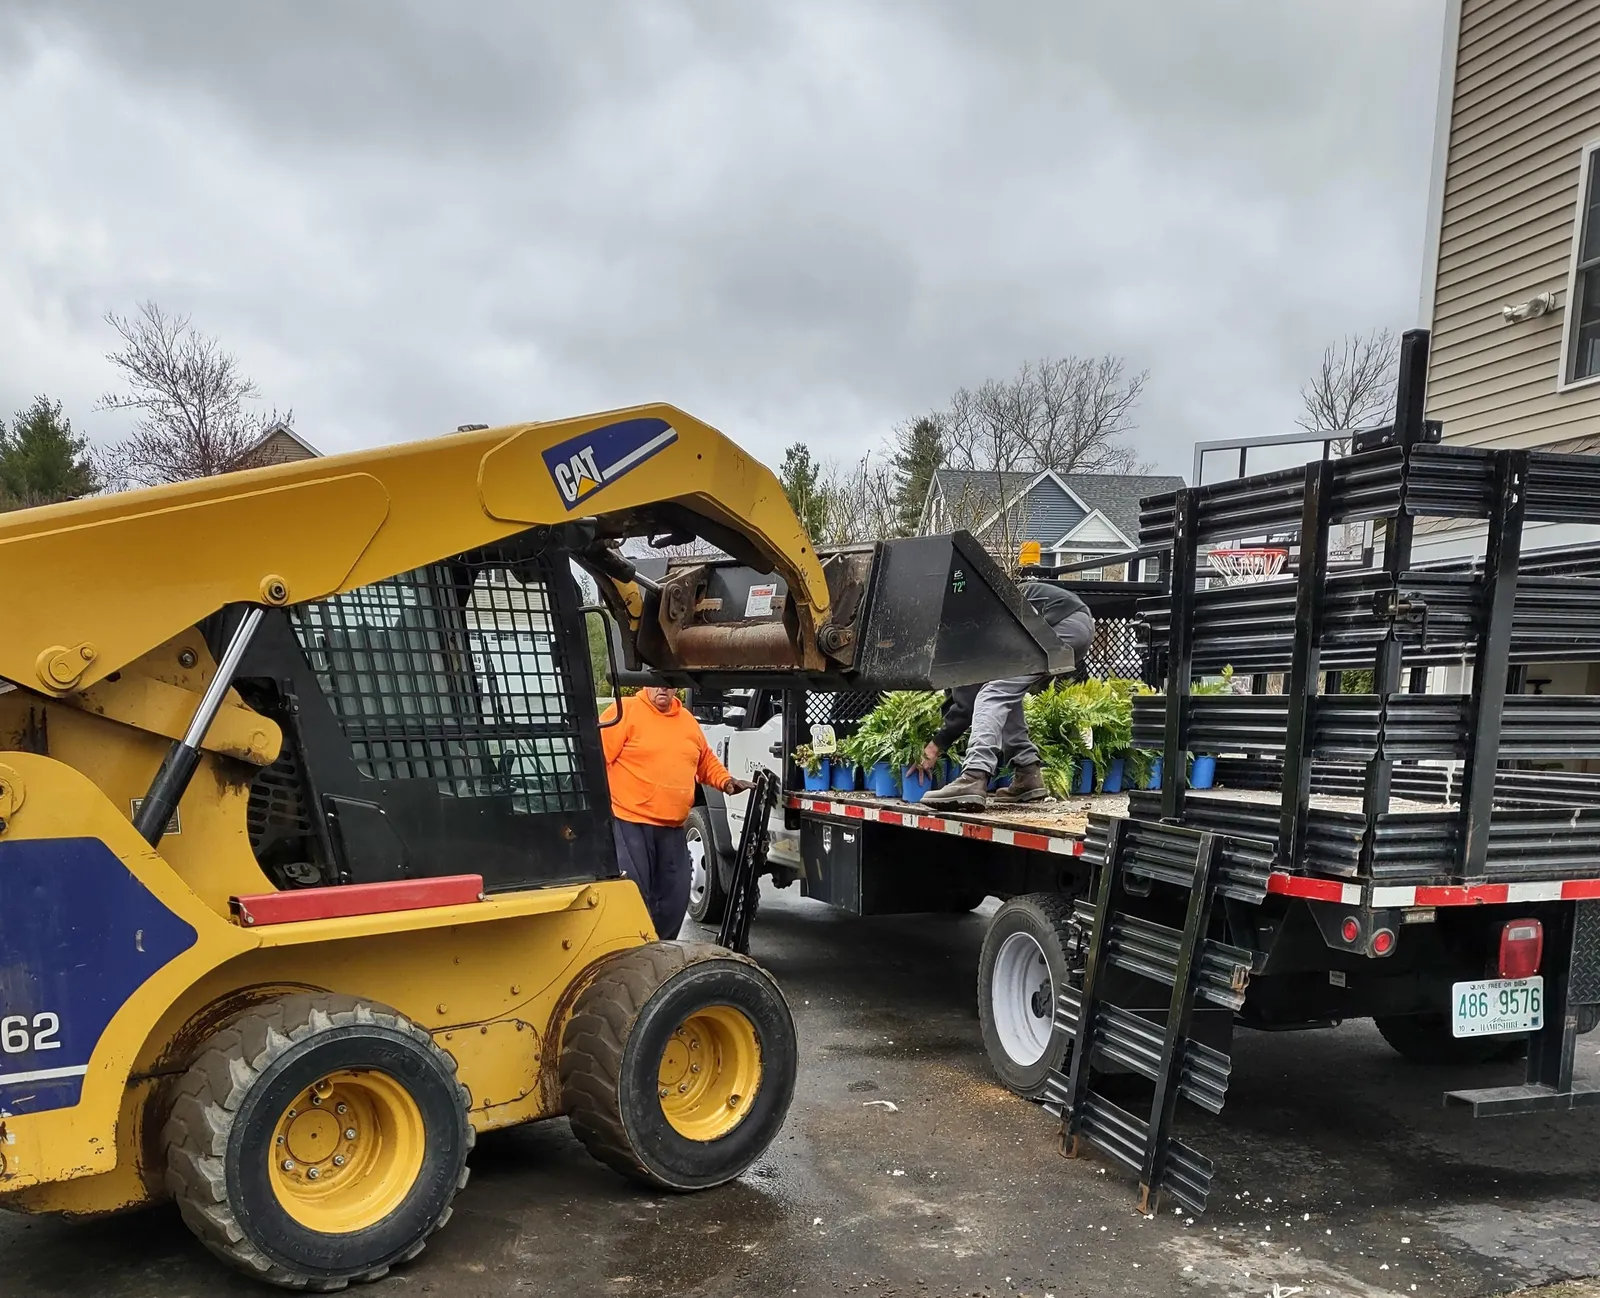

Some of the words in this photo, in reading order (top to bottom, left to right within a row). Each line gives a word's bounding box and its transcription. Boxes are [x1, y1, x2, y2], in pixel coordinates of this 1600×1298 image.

[555, 446, 602, 502] CAT
[1458, 991, 1488, 1019] 486
[1499, 987, 1540, 1015] 9576
[1, 1012, 61, 1053] 62
[1480, 1020, 1518, 1031] HAMPSHIRE
